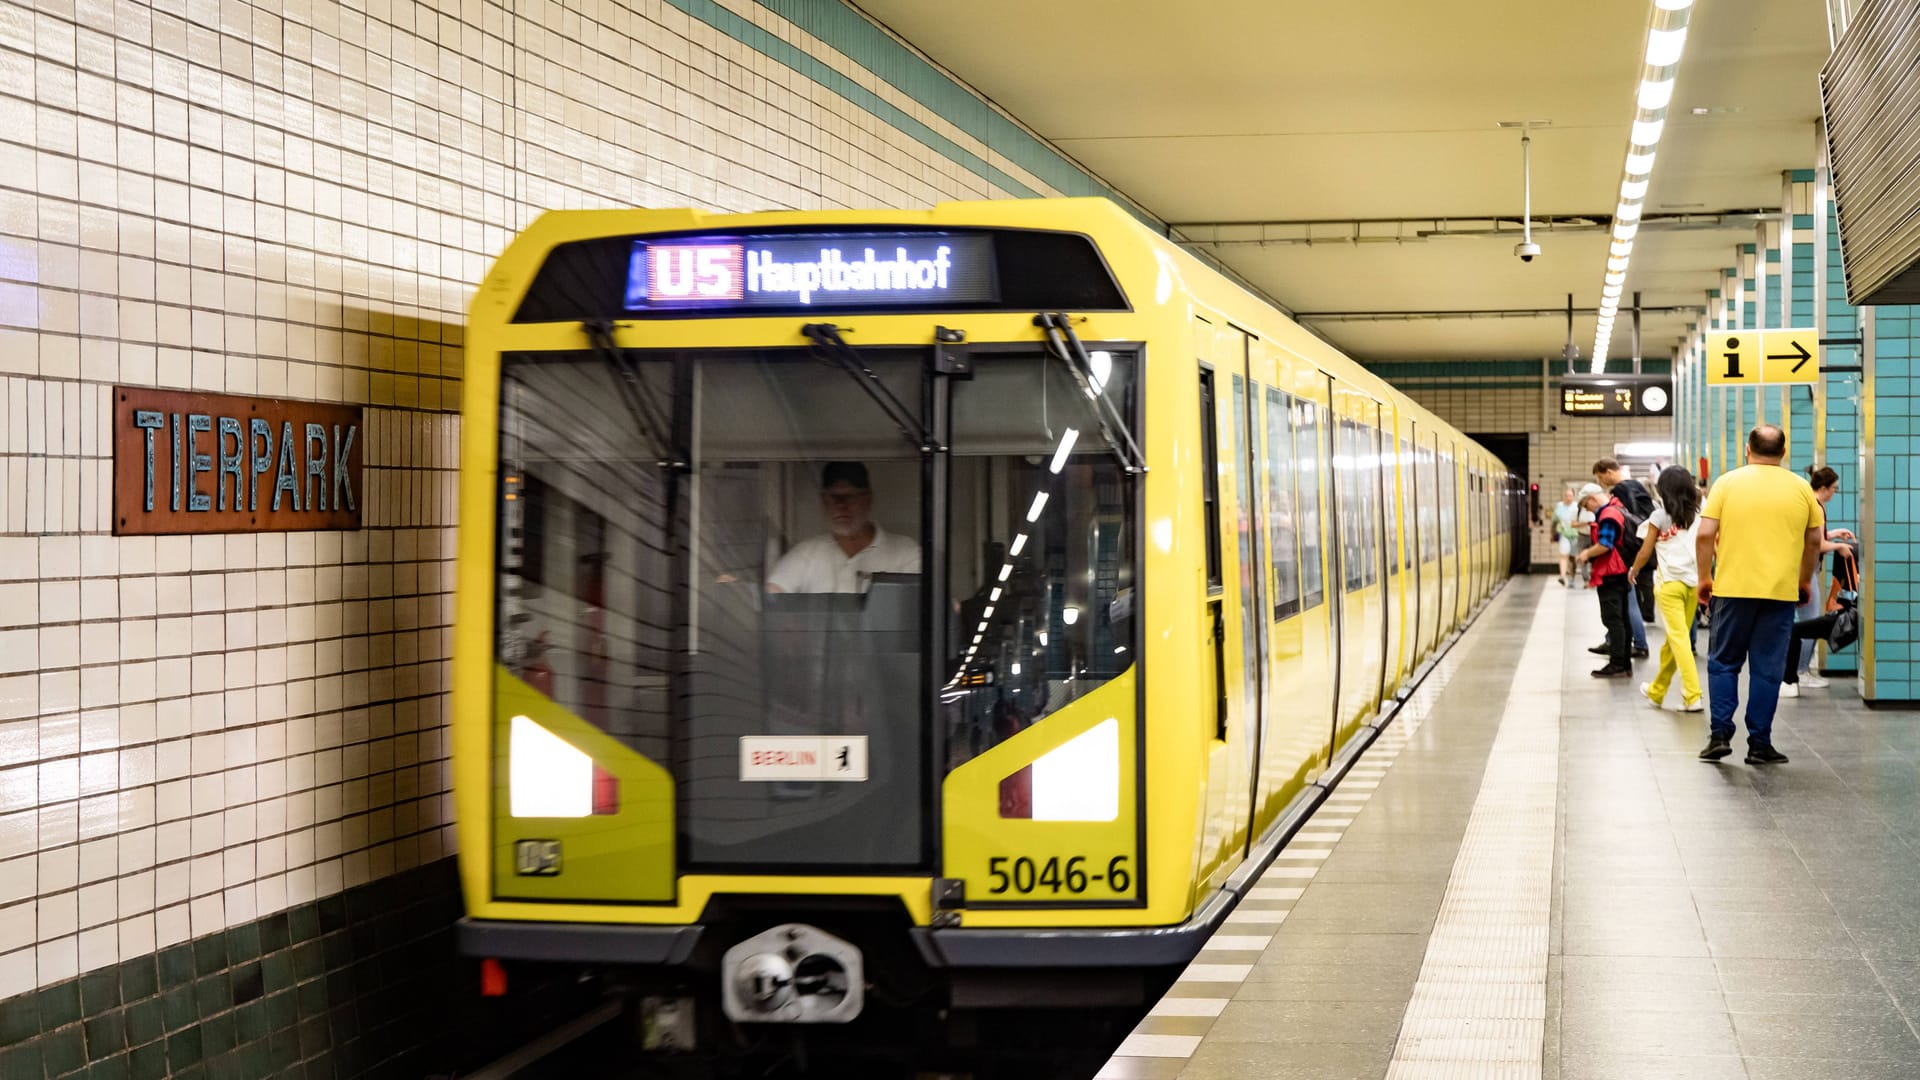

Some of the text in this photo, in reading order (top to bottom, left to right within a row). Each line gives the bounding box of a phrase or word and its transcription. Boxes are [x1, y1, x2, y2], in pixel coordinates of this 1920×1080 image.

[655, 246, 952, 305] U5 Hauptbahnhof
[136, 410, 357, 512] TIERPARK
[751, 750, 817, 766] BERLIN
[988, 855, 1131, 894] 5046-6
